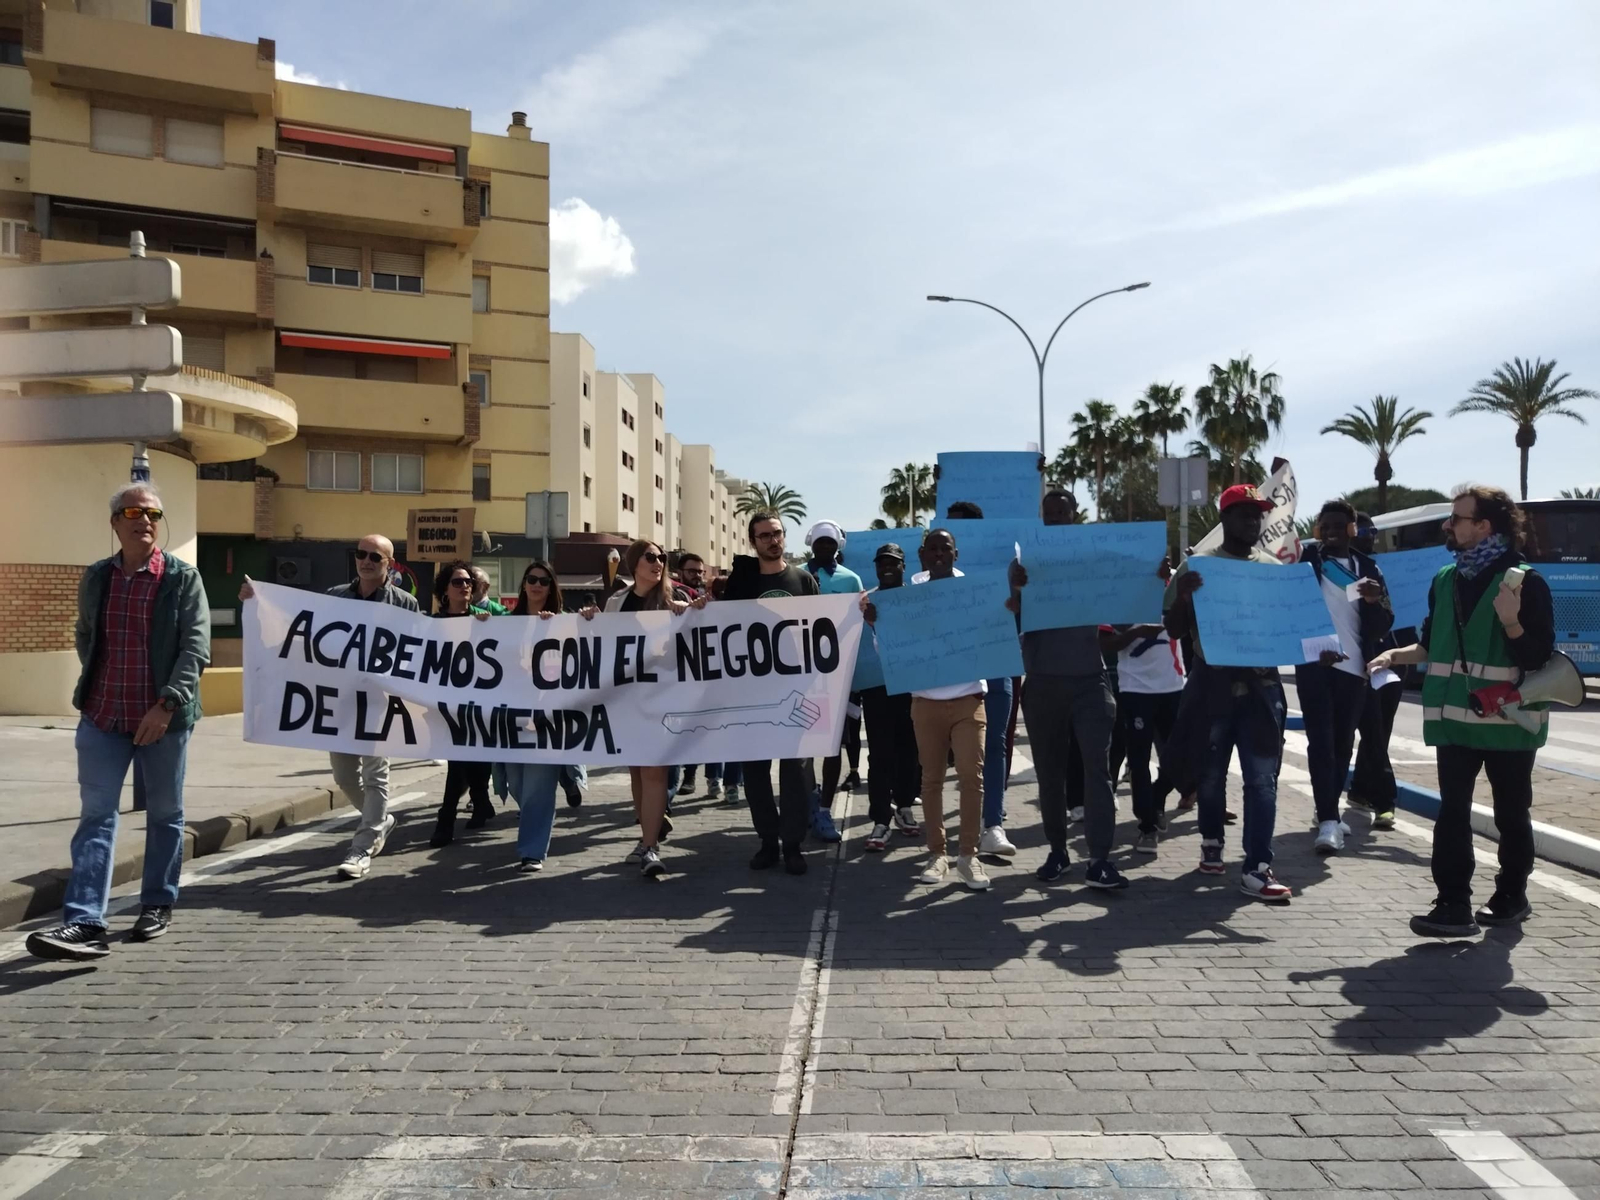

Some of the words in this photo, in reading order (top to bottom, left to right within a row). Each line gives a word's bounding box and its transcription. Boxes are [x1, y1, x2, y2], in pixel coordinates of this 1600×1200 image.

[417, 515, 441, 523] ACABEMOS
[441, 515, 451, 523] CON
[418, 528, 457, 541] NEGOCIO
[417, 544, 425, 553] DE
[425, 544, 433, 553] LA
[279, 610, 502, 689] ACABEMOS
[532, 637, 602, 690] CON
[613, 636, 658, 686] EL
[279, 681, 339, 736] DE
[355, 690, 417, 747] LA
